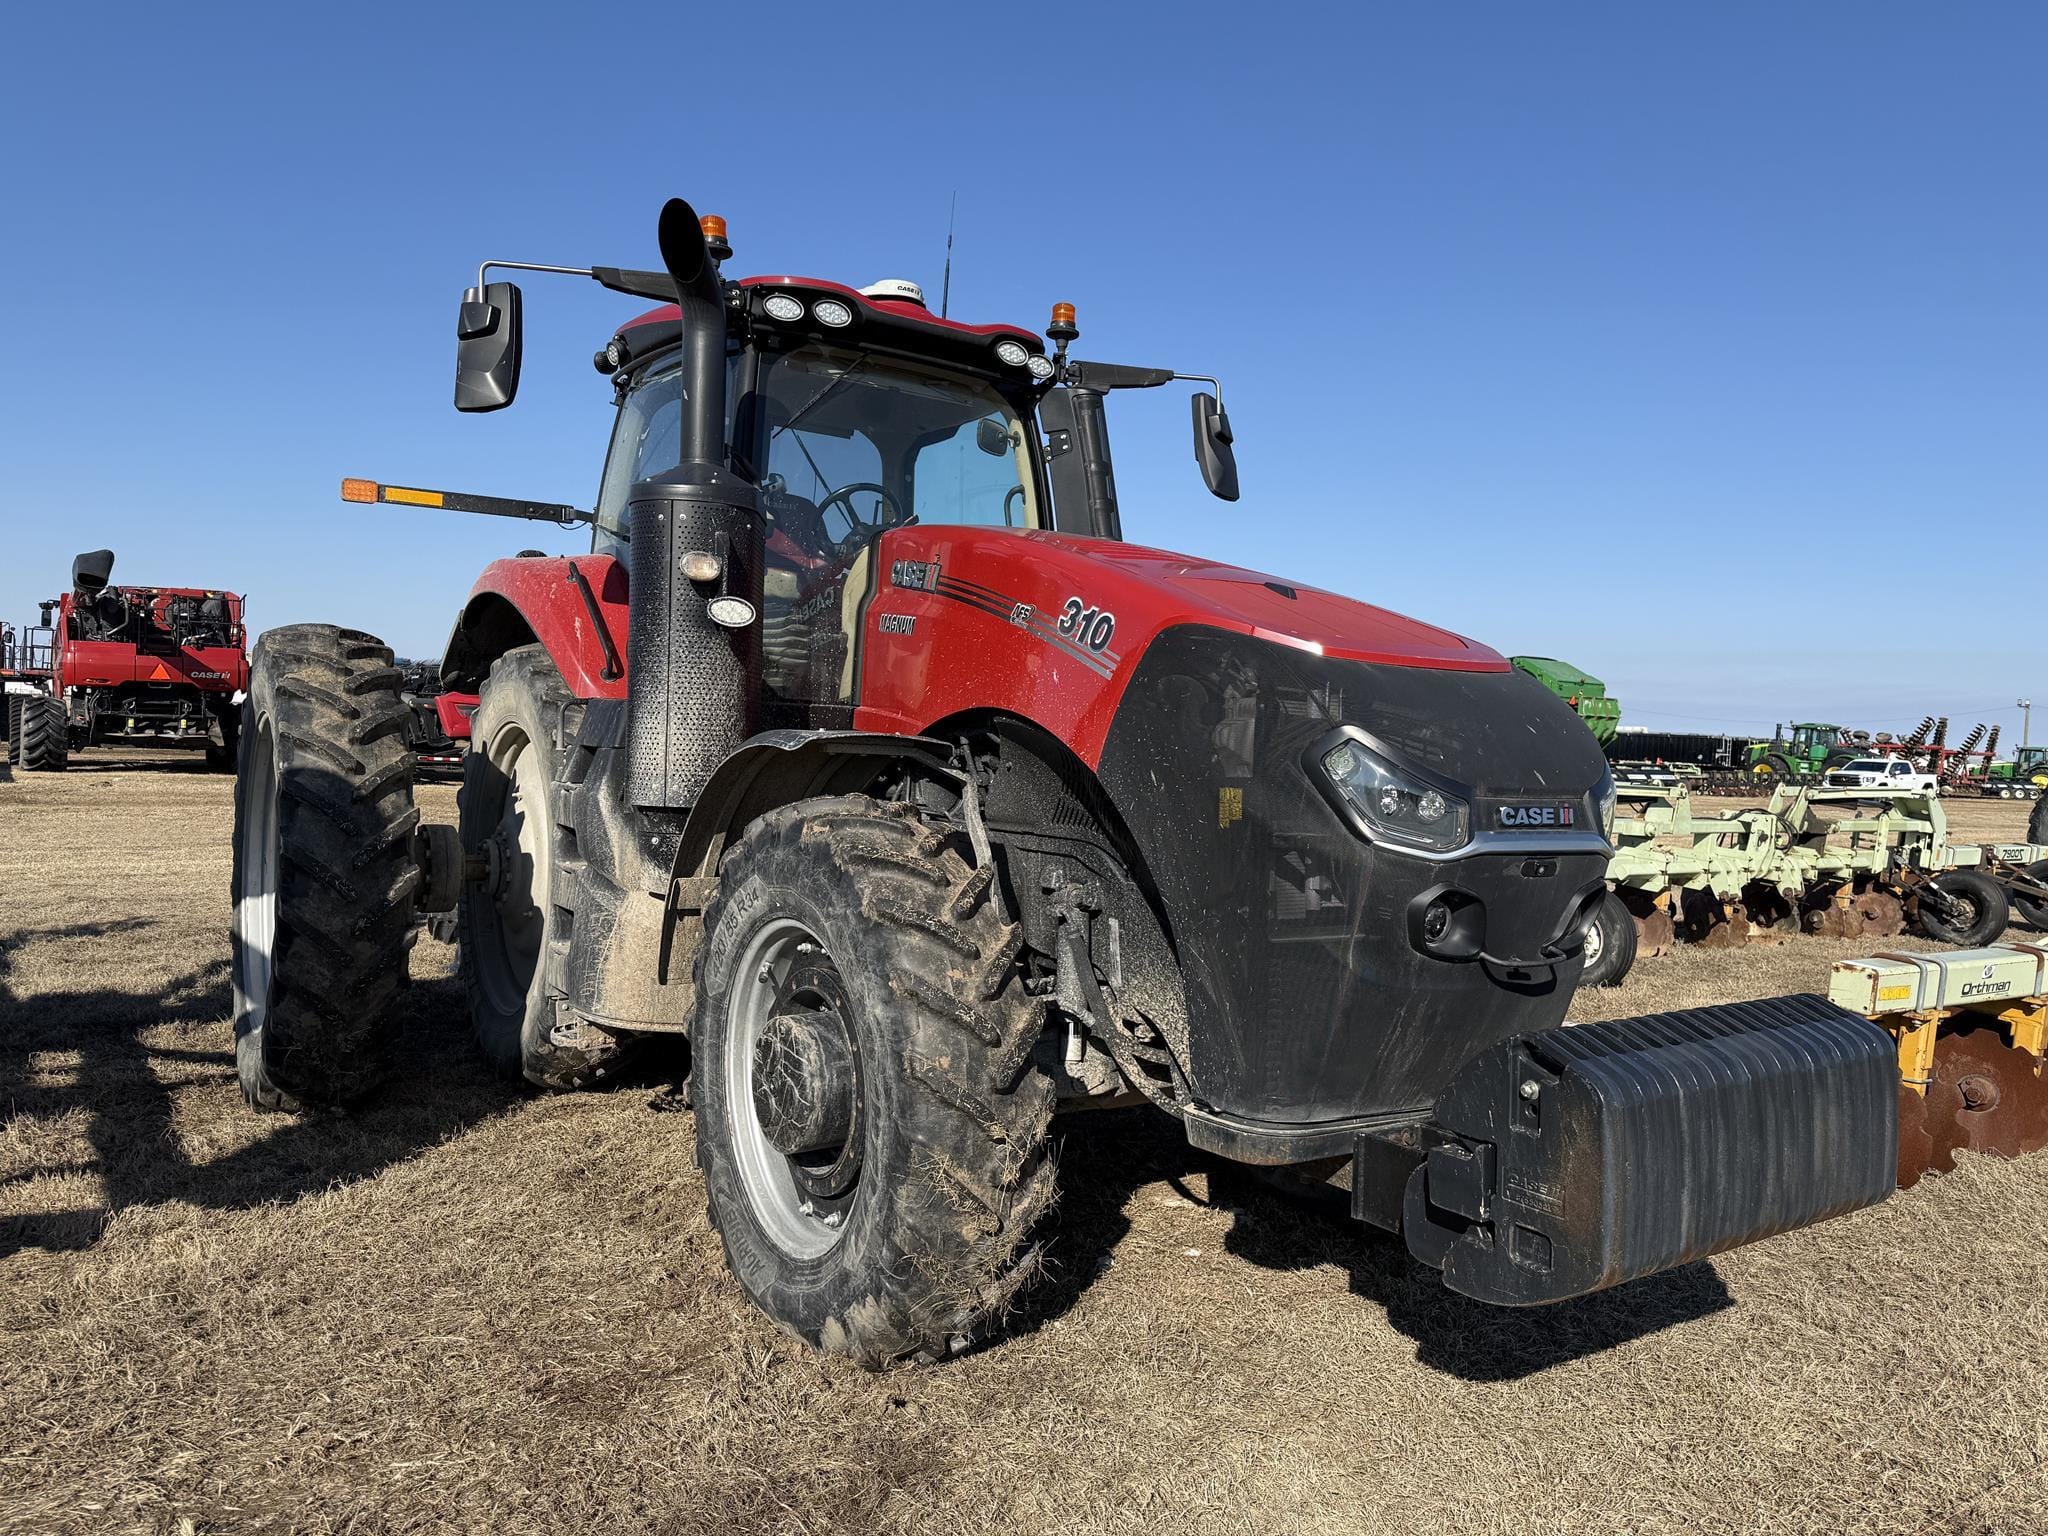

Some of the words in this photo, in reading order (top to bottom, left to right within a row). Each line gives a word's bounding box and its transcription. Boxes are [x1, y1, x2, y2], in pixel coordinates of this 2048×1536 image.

[890, 558, 927, 589] CASE
[878, 613, 917, 637] MAGNUM
[1057, 595, 1116, 654] 310
[190, 671, 220, 679] CASE
[1500, 806, 1555, 826] CASE
[736, 886, 761, 915] R34
[1961, 981, 2011, 996] Orthman
